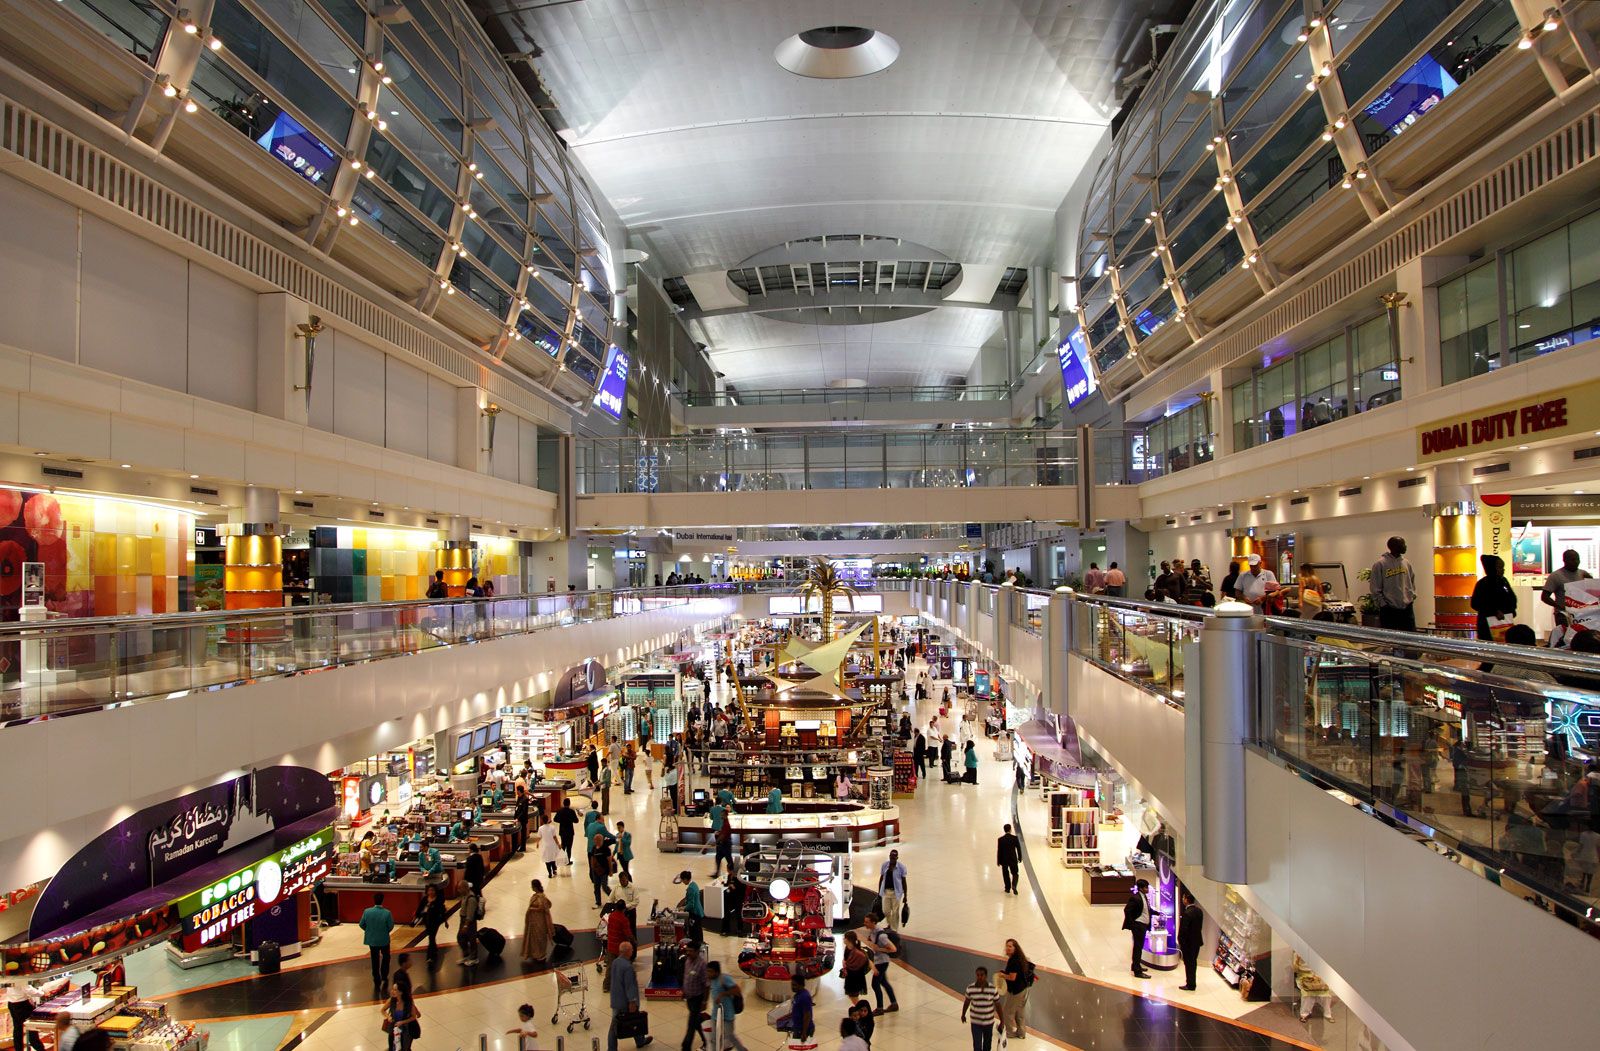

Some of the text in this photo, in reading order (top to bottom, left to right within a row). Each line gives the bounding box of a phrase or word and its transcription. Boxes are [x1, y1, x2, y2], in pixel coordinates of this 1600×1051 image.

[1421, 398, 1568, 455] DUBAI DUTY FREE
[676, 532, 694, 540] Dubai
[1492, 527, 1500, 555] Duba
[164, 834, 218, 862] Ramadan Kareem
[201, 869, 254, 906] FOOD
[193, 886, 255, 929] TOBACCO
[200, 902, 255, 944] DUTY FREE
